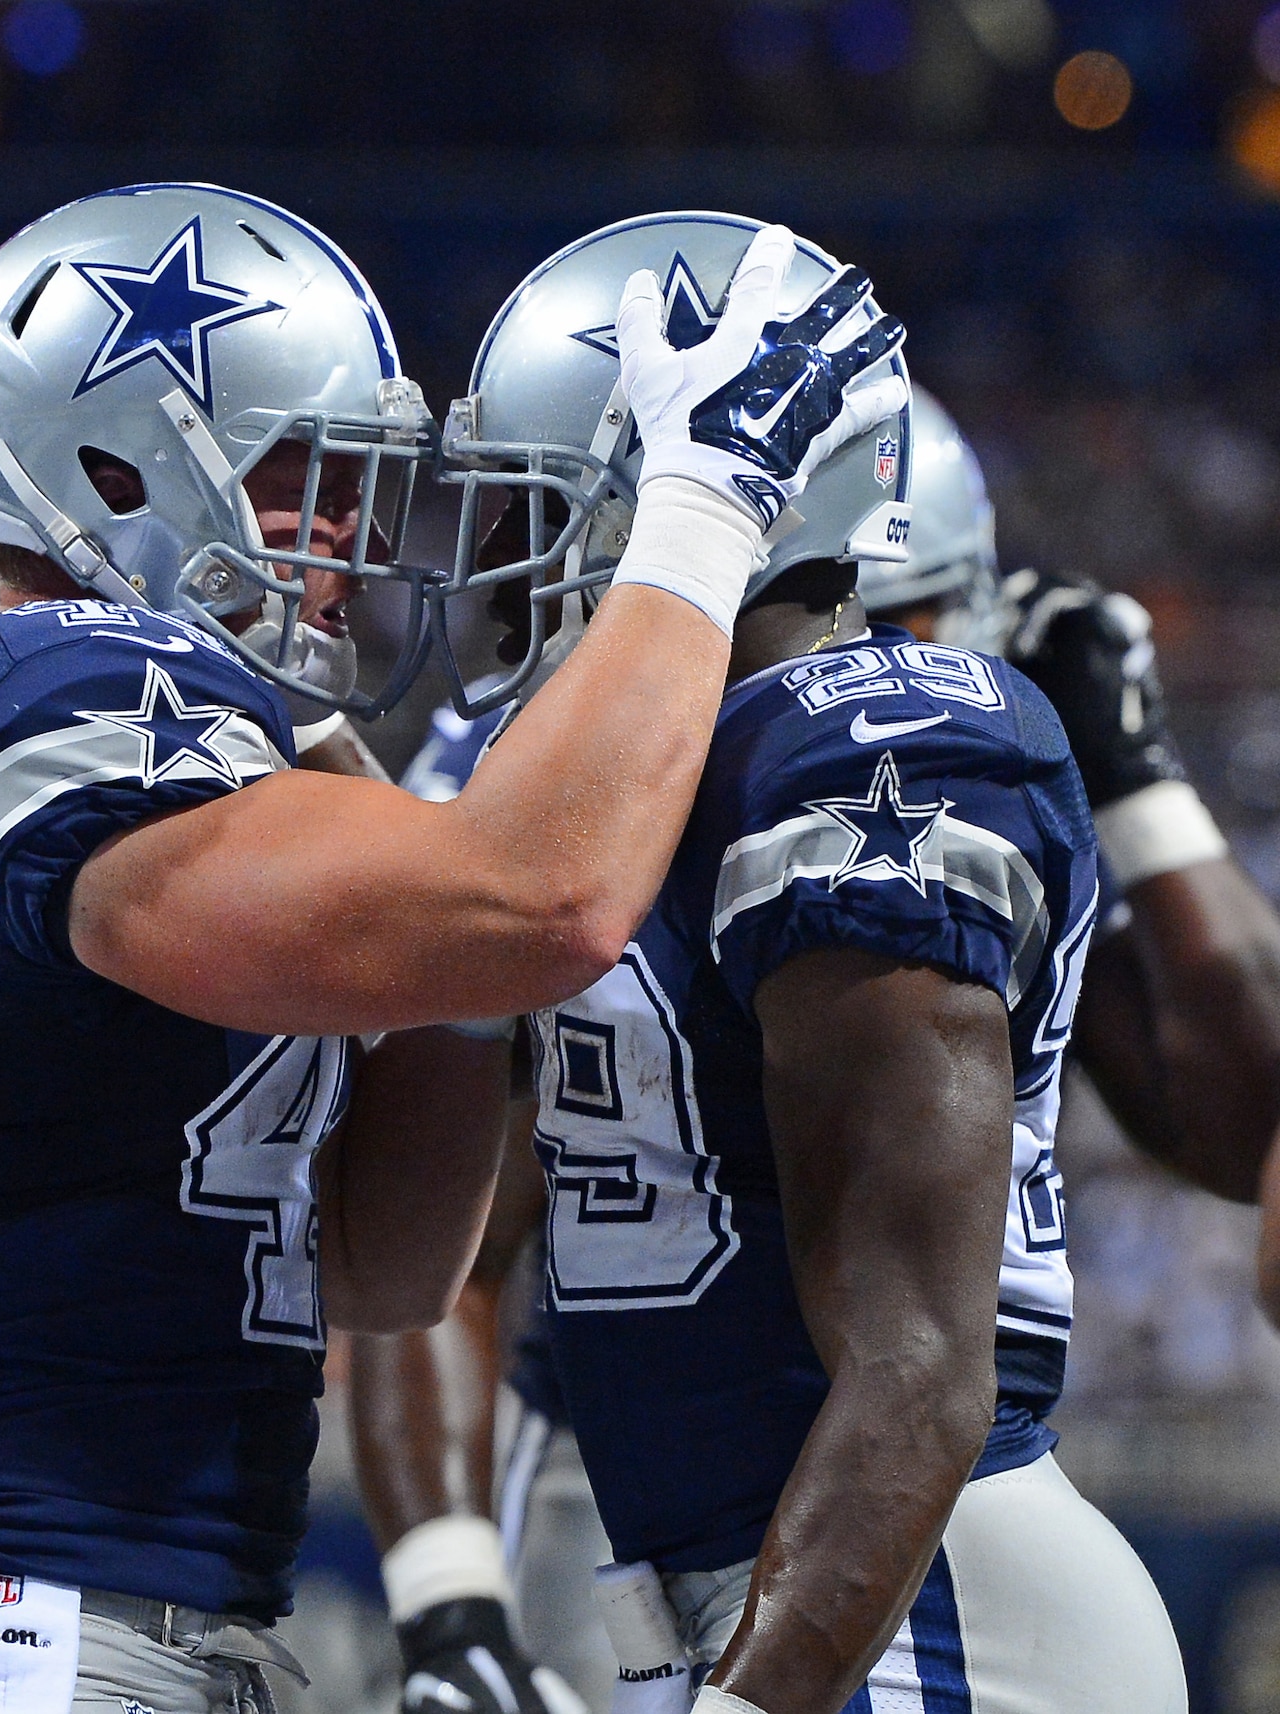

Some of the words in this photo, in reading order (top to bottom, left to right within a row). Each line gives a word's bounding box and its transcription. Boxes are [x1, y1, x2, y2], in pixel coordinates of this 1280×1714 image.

[877, 457, 894, 479] NFL
[781, 641, 1006, 716] 29
[179, 1034, 348, 1350] 4
[532, 941, 741, 1312] 9
